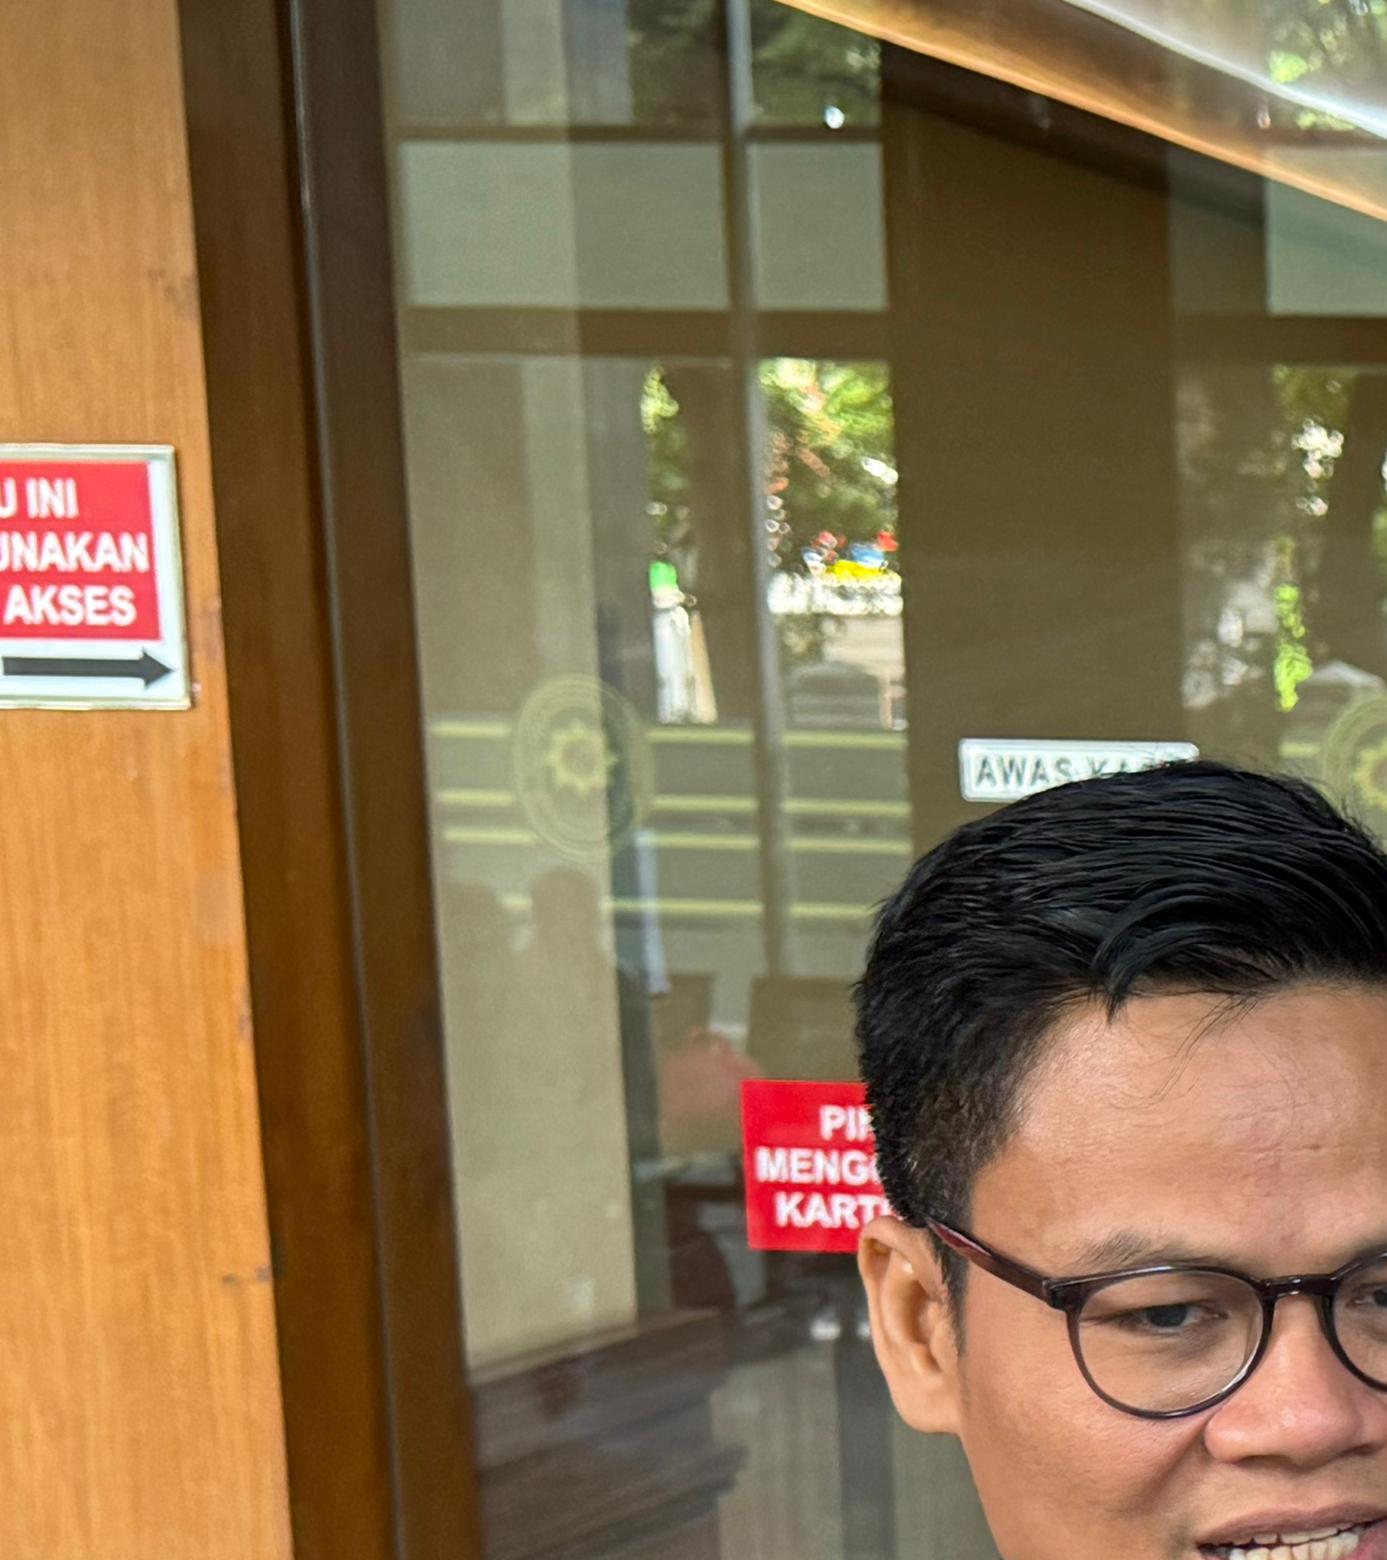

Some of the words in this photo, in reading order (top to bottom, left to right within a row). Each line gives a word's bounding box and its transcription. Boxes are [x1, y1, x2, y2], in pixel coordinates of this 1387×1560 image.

[25, 477, 80, 519] INI
[3, 584, 138, 627] AKSES
[975, 755, 1073, 788] AWAS
